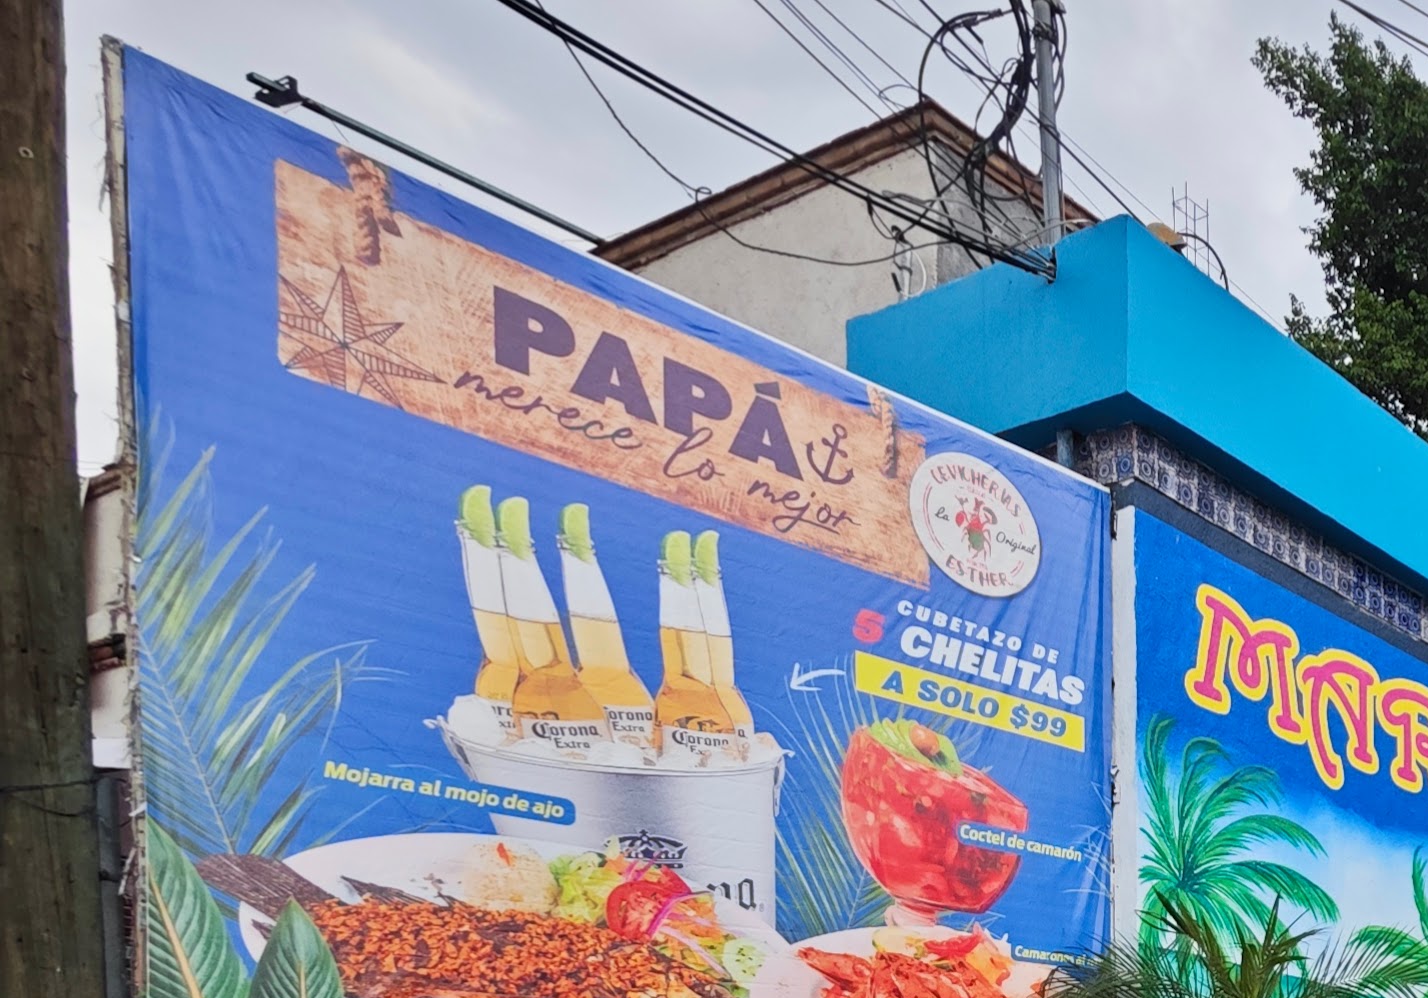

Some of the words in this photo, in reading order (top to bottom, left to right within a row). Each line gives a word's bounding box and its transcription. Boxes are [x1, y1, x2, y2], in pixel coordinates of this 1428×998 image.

[493, 285, 803, 480] PAPÁ
[454, 370, 642, 450] merece
[663, 427, 725, 480] lo
[748, 478, 861, 533] mejor
[996, 531, 1037, 555] Original
[946, 554, 1013, 587] ESTHER
[852, 608, 886, 644] 5
[897, 600, 1022, 650] CUBETAZO
[1032, 643, 1059, 664] DE
[900, 626, 1085, 705] CHELITAS
[607, 709, 653, 721] orona
[881, 671, 904, 694] A
[917, 680, 999, 719] SOLO
[1010, 703, 1067, 737] $99
[532, 721, 599, 740] Corona
[553, 737, 591, 748] Extra
[612, 721, 645, 732] Extra
[324, 760, 415, 792] Mojarra
[418, 779, 441, 797] al
[444, 786, 500, 808] mojo
[502, 794, 530, 812] de
[532, 800, 564, 819] ajo
[960, 824, 1005, 846] Coctel
[1007, 834, 1025, 850] de
[1026, 841, 1082, 862] camarón
